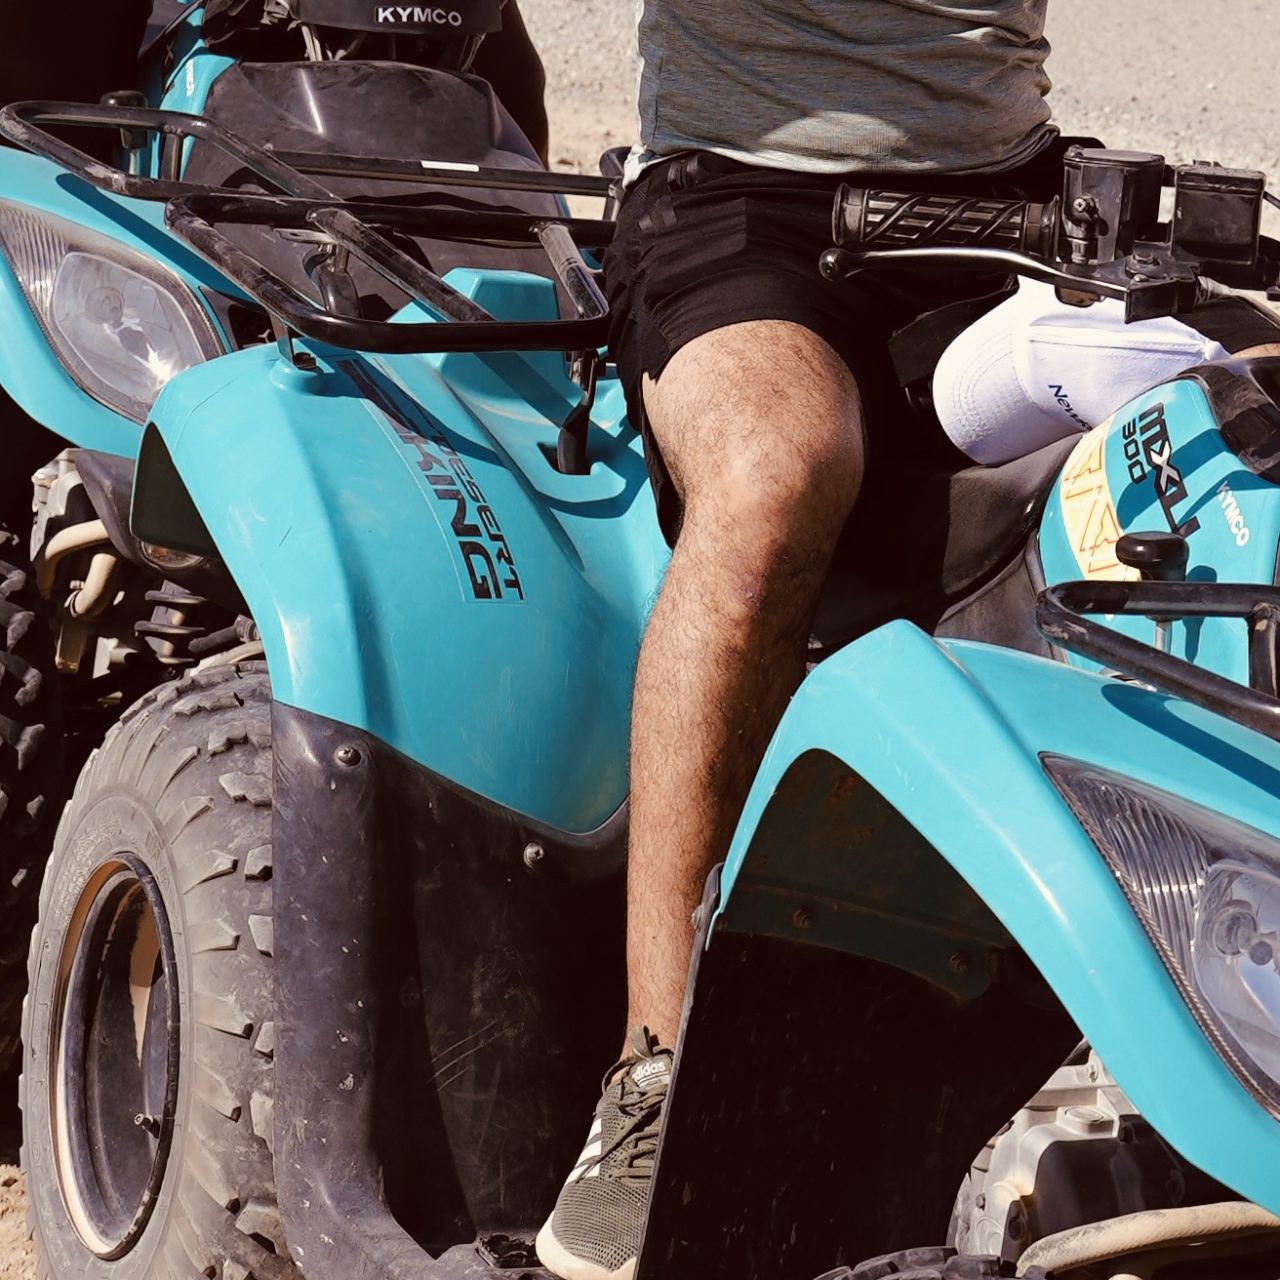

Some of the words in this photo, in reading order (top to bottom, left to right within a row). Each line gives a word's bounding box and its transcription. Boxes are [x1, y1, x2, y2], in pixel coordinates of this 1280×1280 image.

[378, 7, 462, 26] KYMCO
[1122, 417, 1147, 484] 300
[400, 434, 503, 600] KING
[1217, 480, 1250, 547] KYMCO
